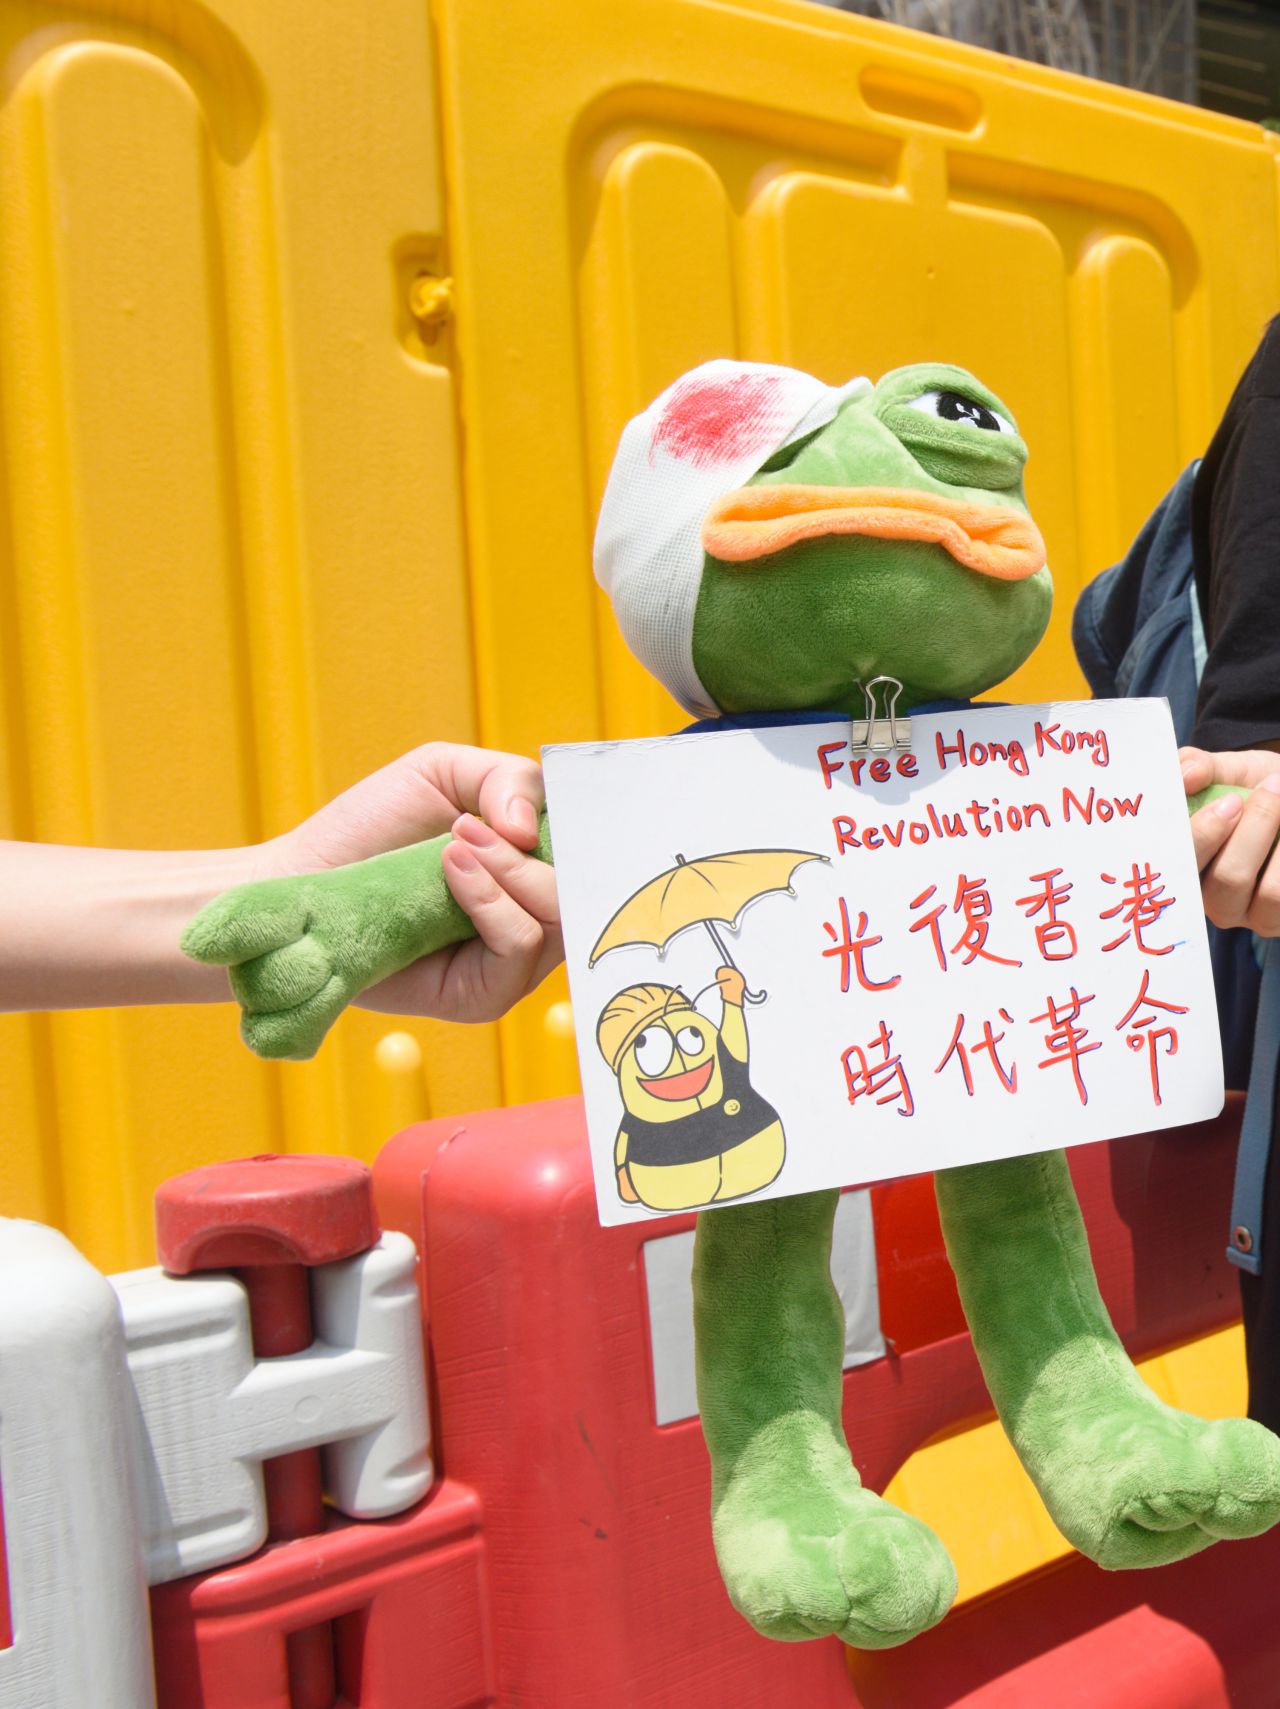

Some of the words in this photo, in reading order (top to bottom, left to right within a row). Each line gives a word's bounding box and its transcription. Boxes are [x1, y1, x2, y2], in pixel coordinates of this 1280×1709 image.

[817, 741, 920, 790] Free
[935, 729, 1030, 777] Hong
[1034, 721, 1110, 767] Kong
[831, 797, 1052, 856] Revolution
[1062, 786, 1144, 825] Now
[821, 862, 1176, 993] 光復香港
[840, 968, 1190, 1117] 時代革命
